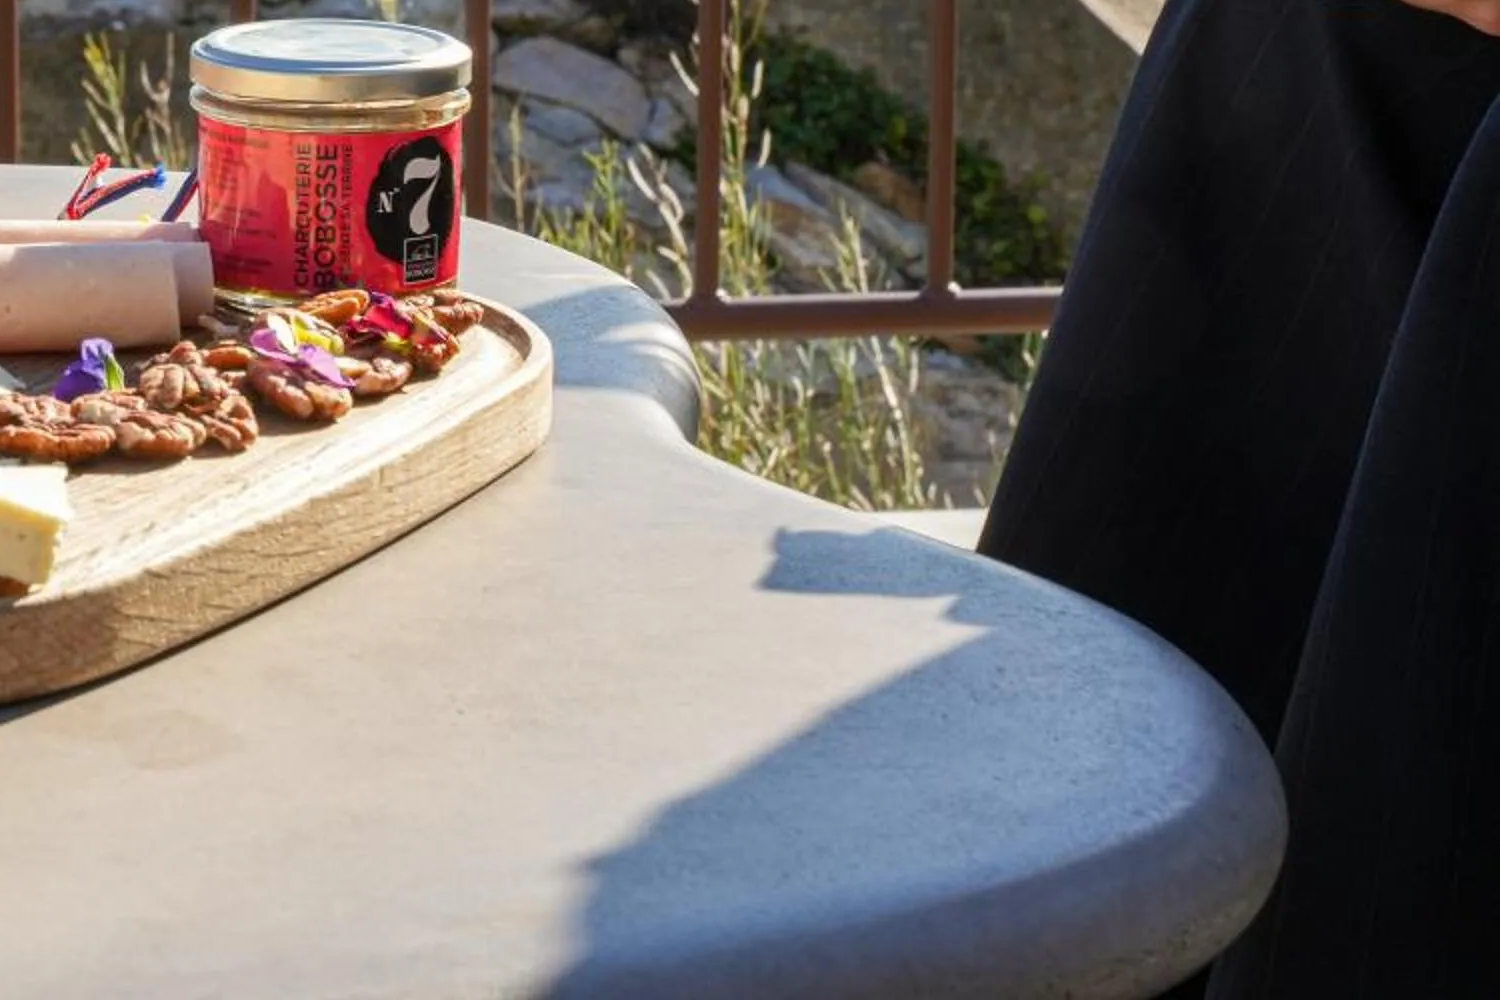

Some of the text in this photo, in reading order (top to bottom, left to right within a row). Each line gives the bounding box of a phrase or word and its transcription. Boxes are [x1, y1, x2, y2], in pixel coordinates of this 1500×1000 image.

[294, 143, 312, 288] CHARCUTERIE
[314, 144, 337, 289] BOBOSSE
[403, 152, 441, 235] 7
